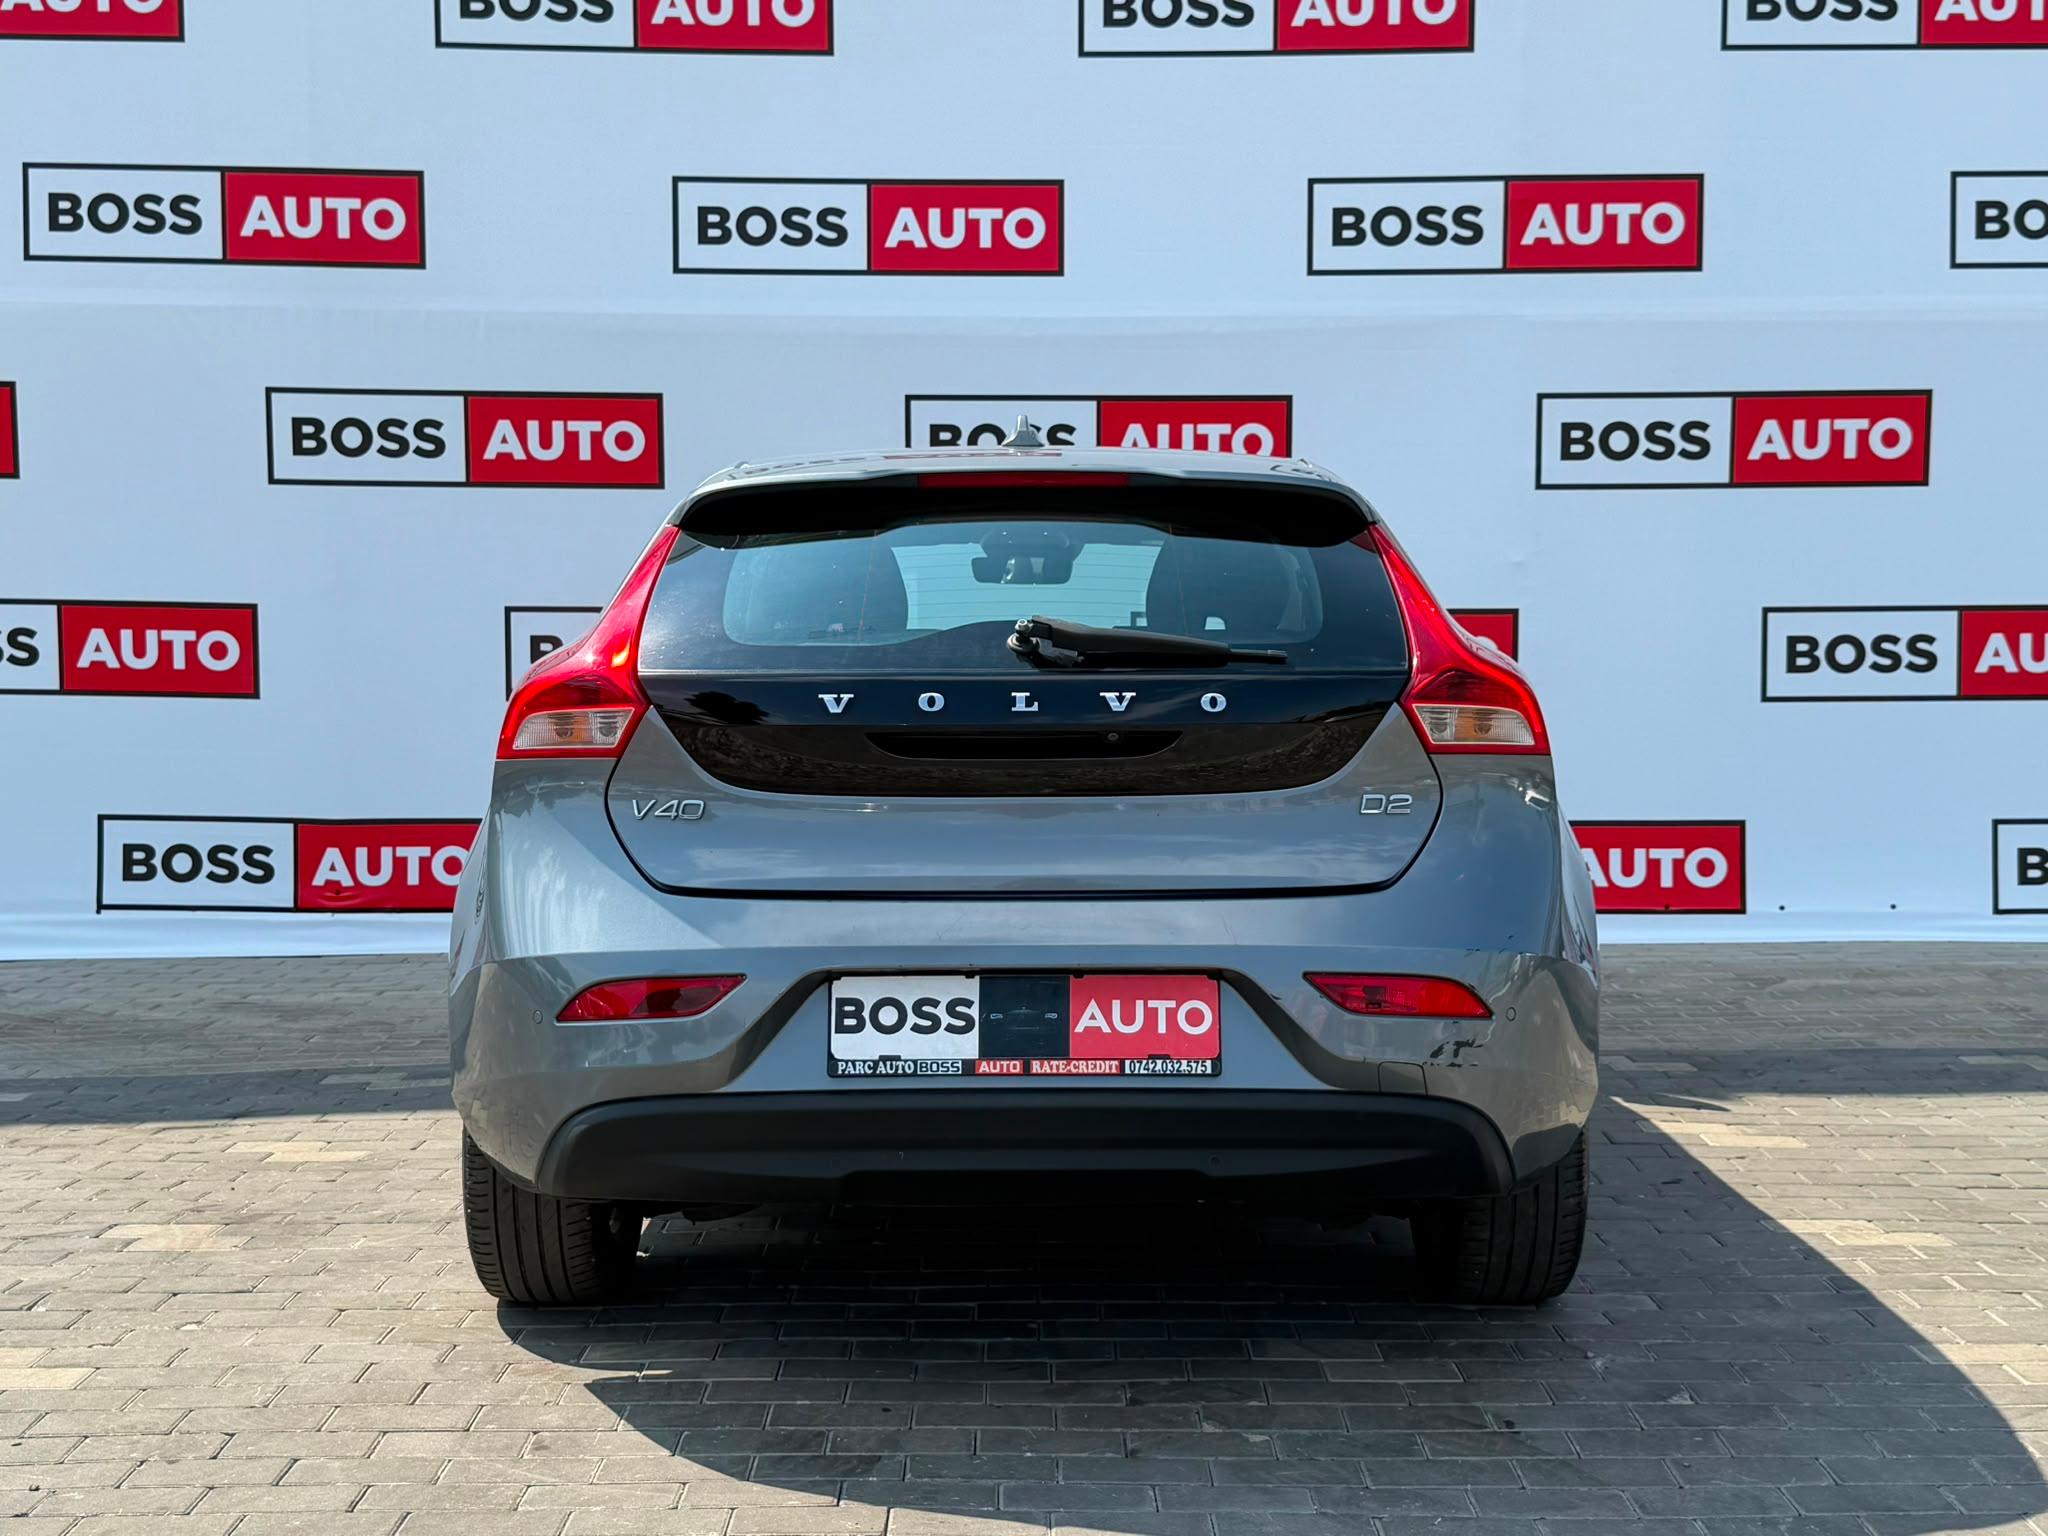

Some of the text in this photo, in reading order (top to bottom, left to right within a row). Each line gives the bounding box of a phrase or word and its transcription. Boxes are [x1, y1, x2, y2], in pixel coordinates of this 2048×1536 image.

[1103, 0, 1254, 27] BOSS
[48, 193, 407, 241] BOSS AUTO
[698, 206, 1046, 249] BOSS AUTO
[1331, 202, 1685, 246] BOSS AUTO
[291, 417, 646, 461] BOSS AUTO
[1560, 418, 1912, 461] BOSS AUTO
[77, 629, 240, 671] AUTO
[1787, 634, 1938, 674] BOSS
[818, 692, 1228, 714] VOLVO
[632, 799, 705, 820] V40
[1360, 794, 1412, 814] D2
[122, 843, 469, 887] BOSS AUTO
[1581, 847, 1729, 888] AUTO
[834, 997, 1213, 1036] BOSS AUTO
[837, 1060, 1208, 1075] PARC AUTO BOSS AUTO RATE-CREDIT 0742.032.575
